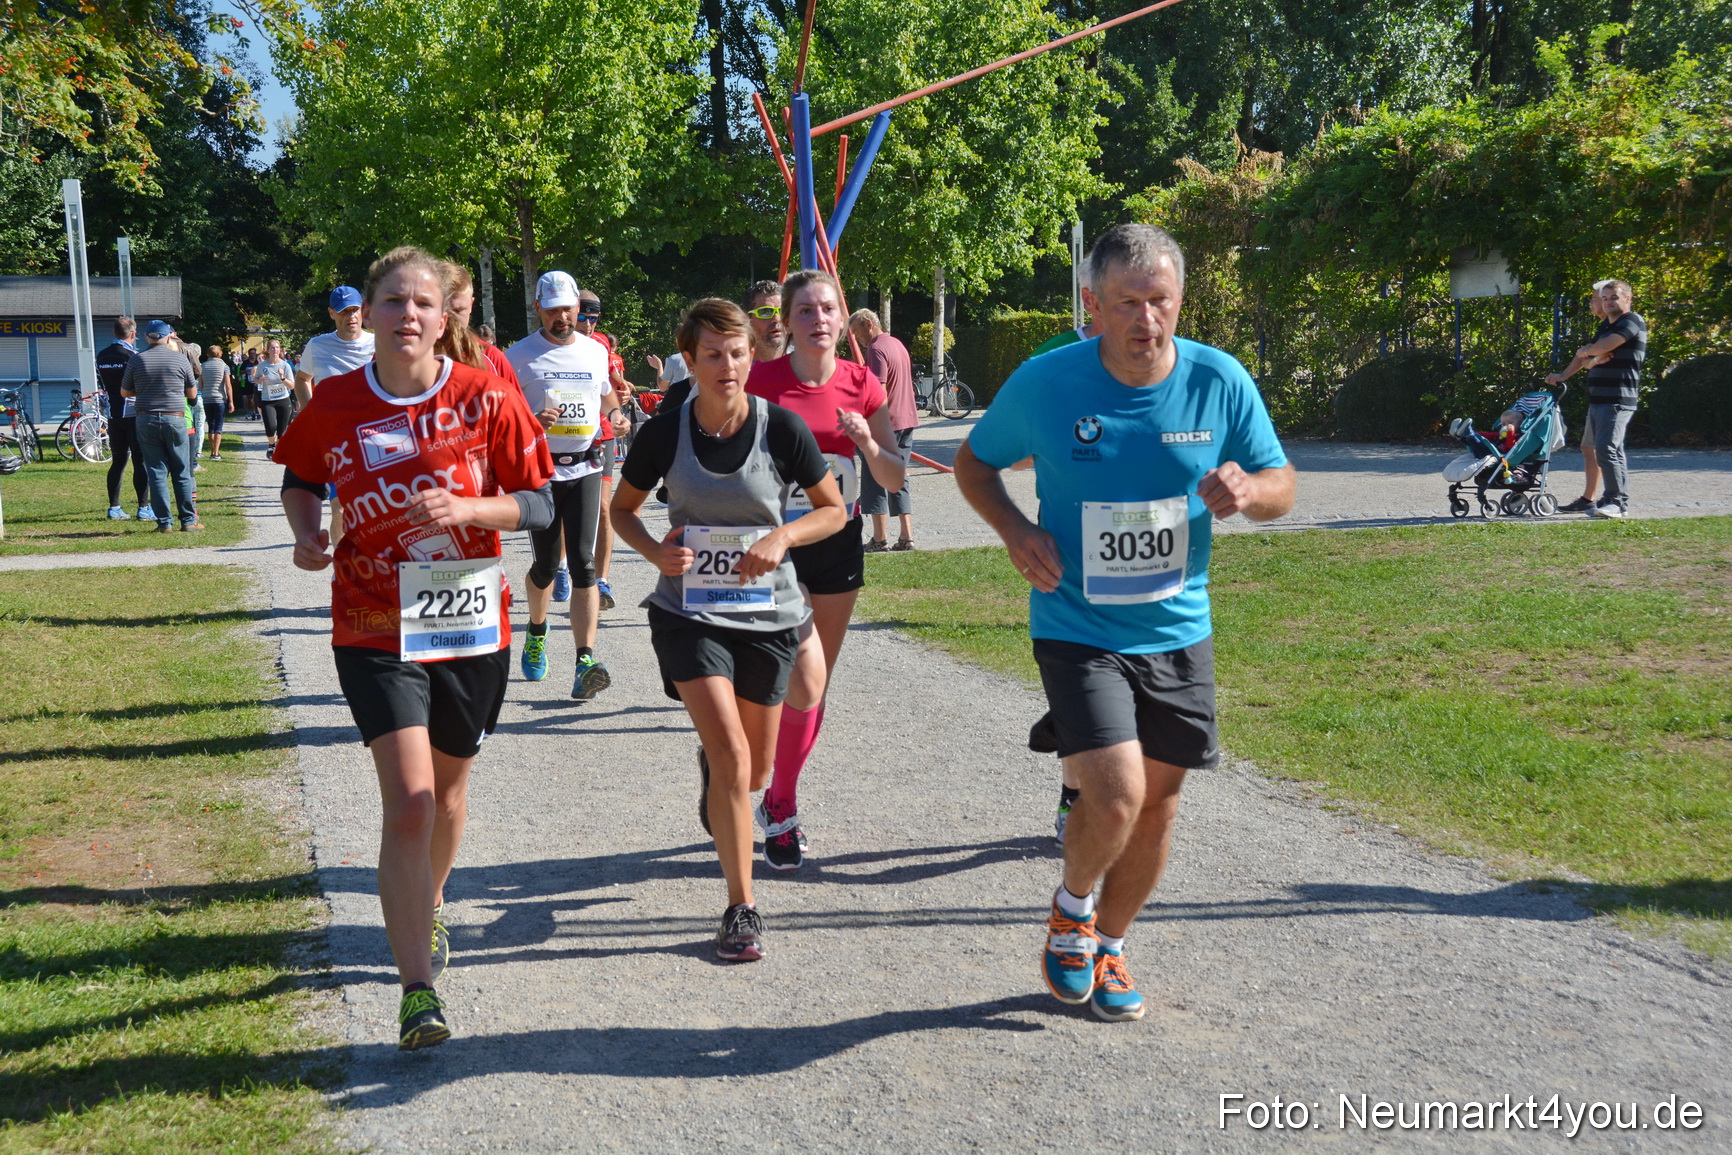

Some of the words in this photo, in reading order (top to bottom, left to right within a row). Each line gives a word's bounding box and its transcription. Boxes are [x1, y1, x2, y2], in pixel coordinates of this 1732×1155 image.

[21, 322, 63, 333] KIOSK
[558, 403, 586, 418] 235
[361, 417, 408, 438] raumbox
[564, 427, 580, 435] Jens
[427, 428, 484, 452] schenken
[1161, 430, 1213, 444] BOCK
[1113, 510, 1159, 523] BOCK
[710, 534, 749, 544] BOCK
[1099, 528, 1174, 561] 3030
[697, 550, 745, 575] 262
[1130, 564, 1160, 572] Neumarkt
[432, 568, 476, 582] BOCK
[417, 585, 487, 620] 2225
[431, 633, 476, 647] Claudia
